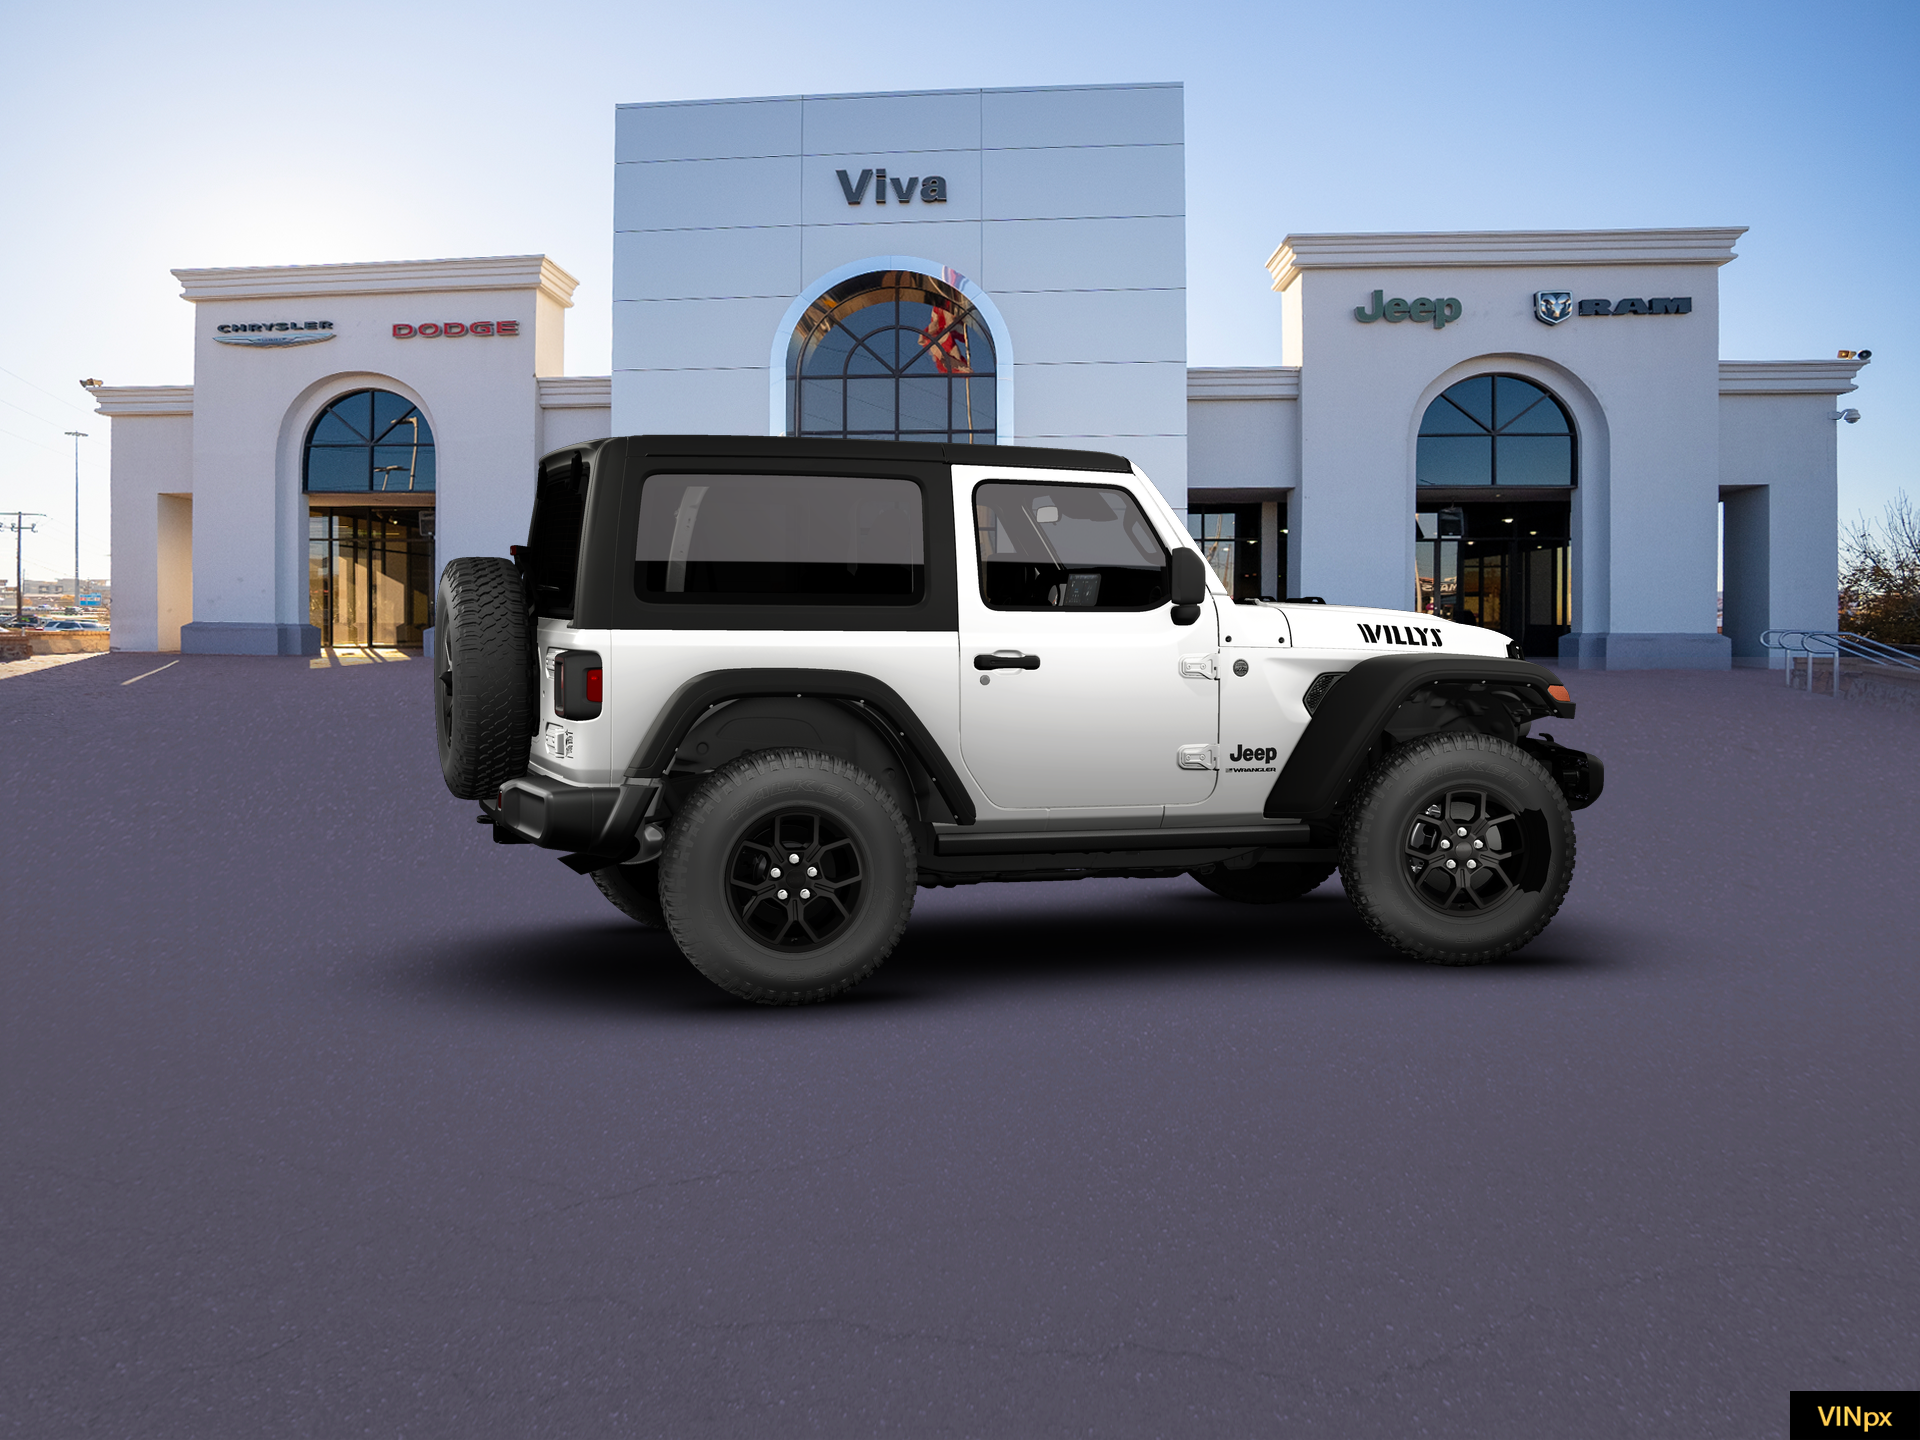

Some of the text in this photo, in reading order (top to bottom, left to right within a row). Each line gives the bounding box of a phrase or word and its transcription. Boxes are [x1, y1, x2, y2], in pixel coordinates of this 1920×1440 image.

[835, 168, 947, 205] Viva
[1354, 289, 1462, 329] Jeep
[1578, 296, 1692, 316] RAM
[217, 320, 334, 334] CHRYSLER
[392, 320, 520, 338] DODGE
[1357, 623, 1443, 647] WILLYS
[1229, 744, 1277, 764] Jeep
[1404, 760, 1531, 796] FALKEN
[726, 779, 866, 820] FALKEN
